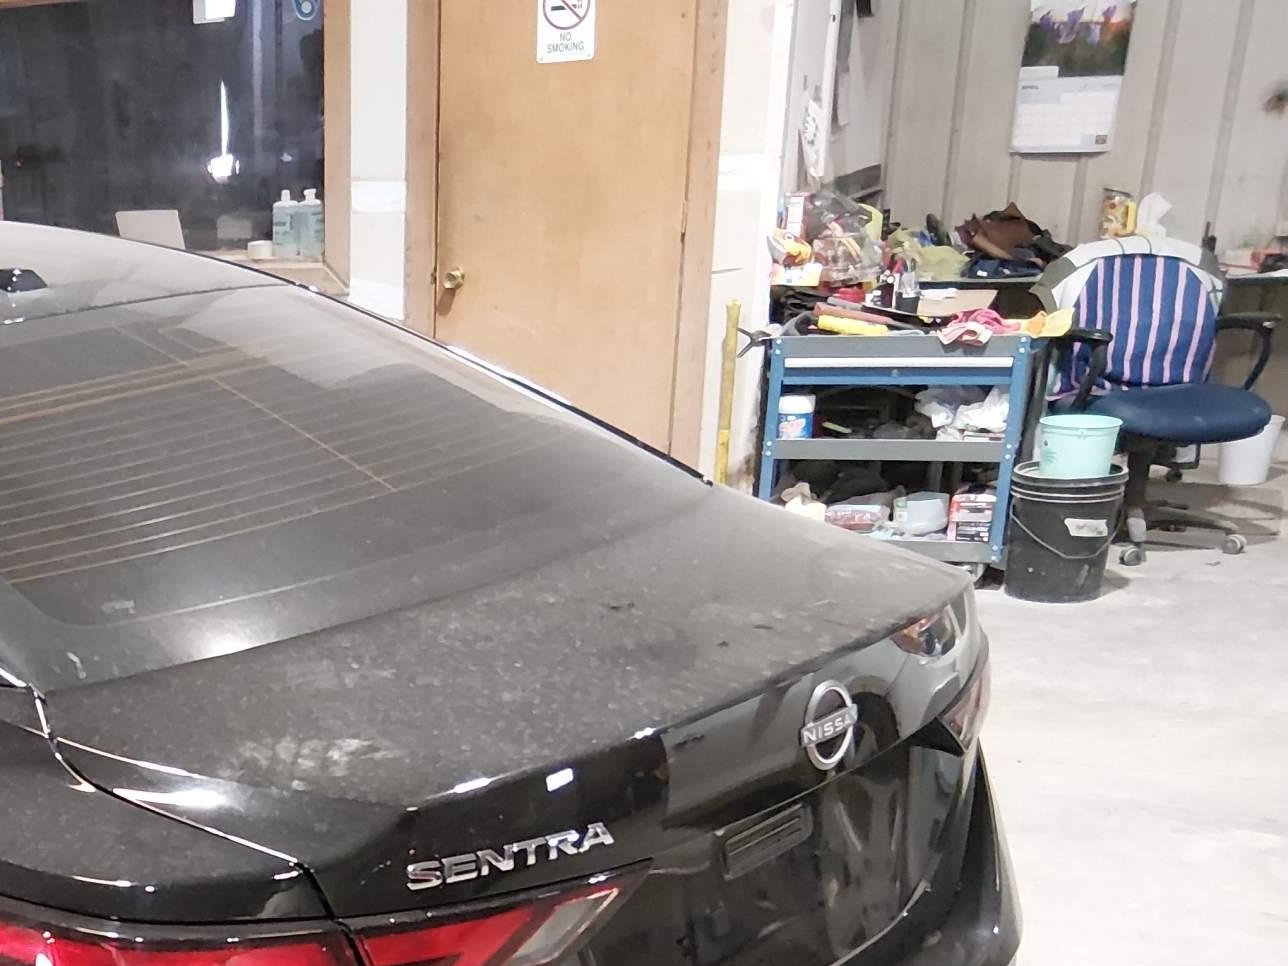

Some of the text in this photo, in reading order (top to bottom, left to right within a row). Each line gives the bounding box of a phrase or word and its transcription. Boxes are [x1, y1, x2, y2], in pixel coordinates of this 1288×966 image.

[559, 32, 572, 42] NO
[546, 41, 585, 54] SMOKING
[406, 822, 615, 891] SENTRA
